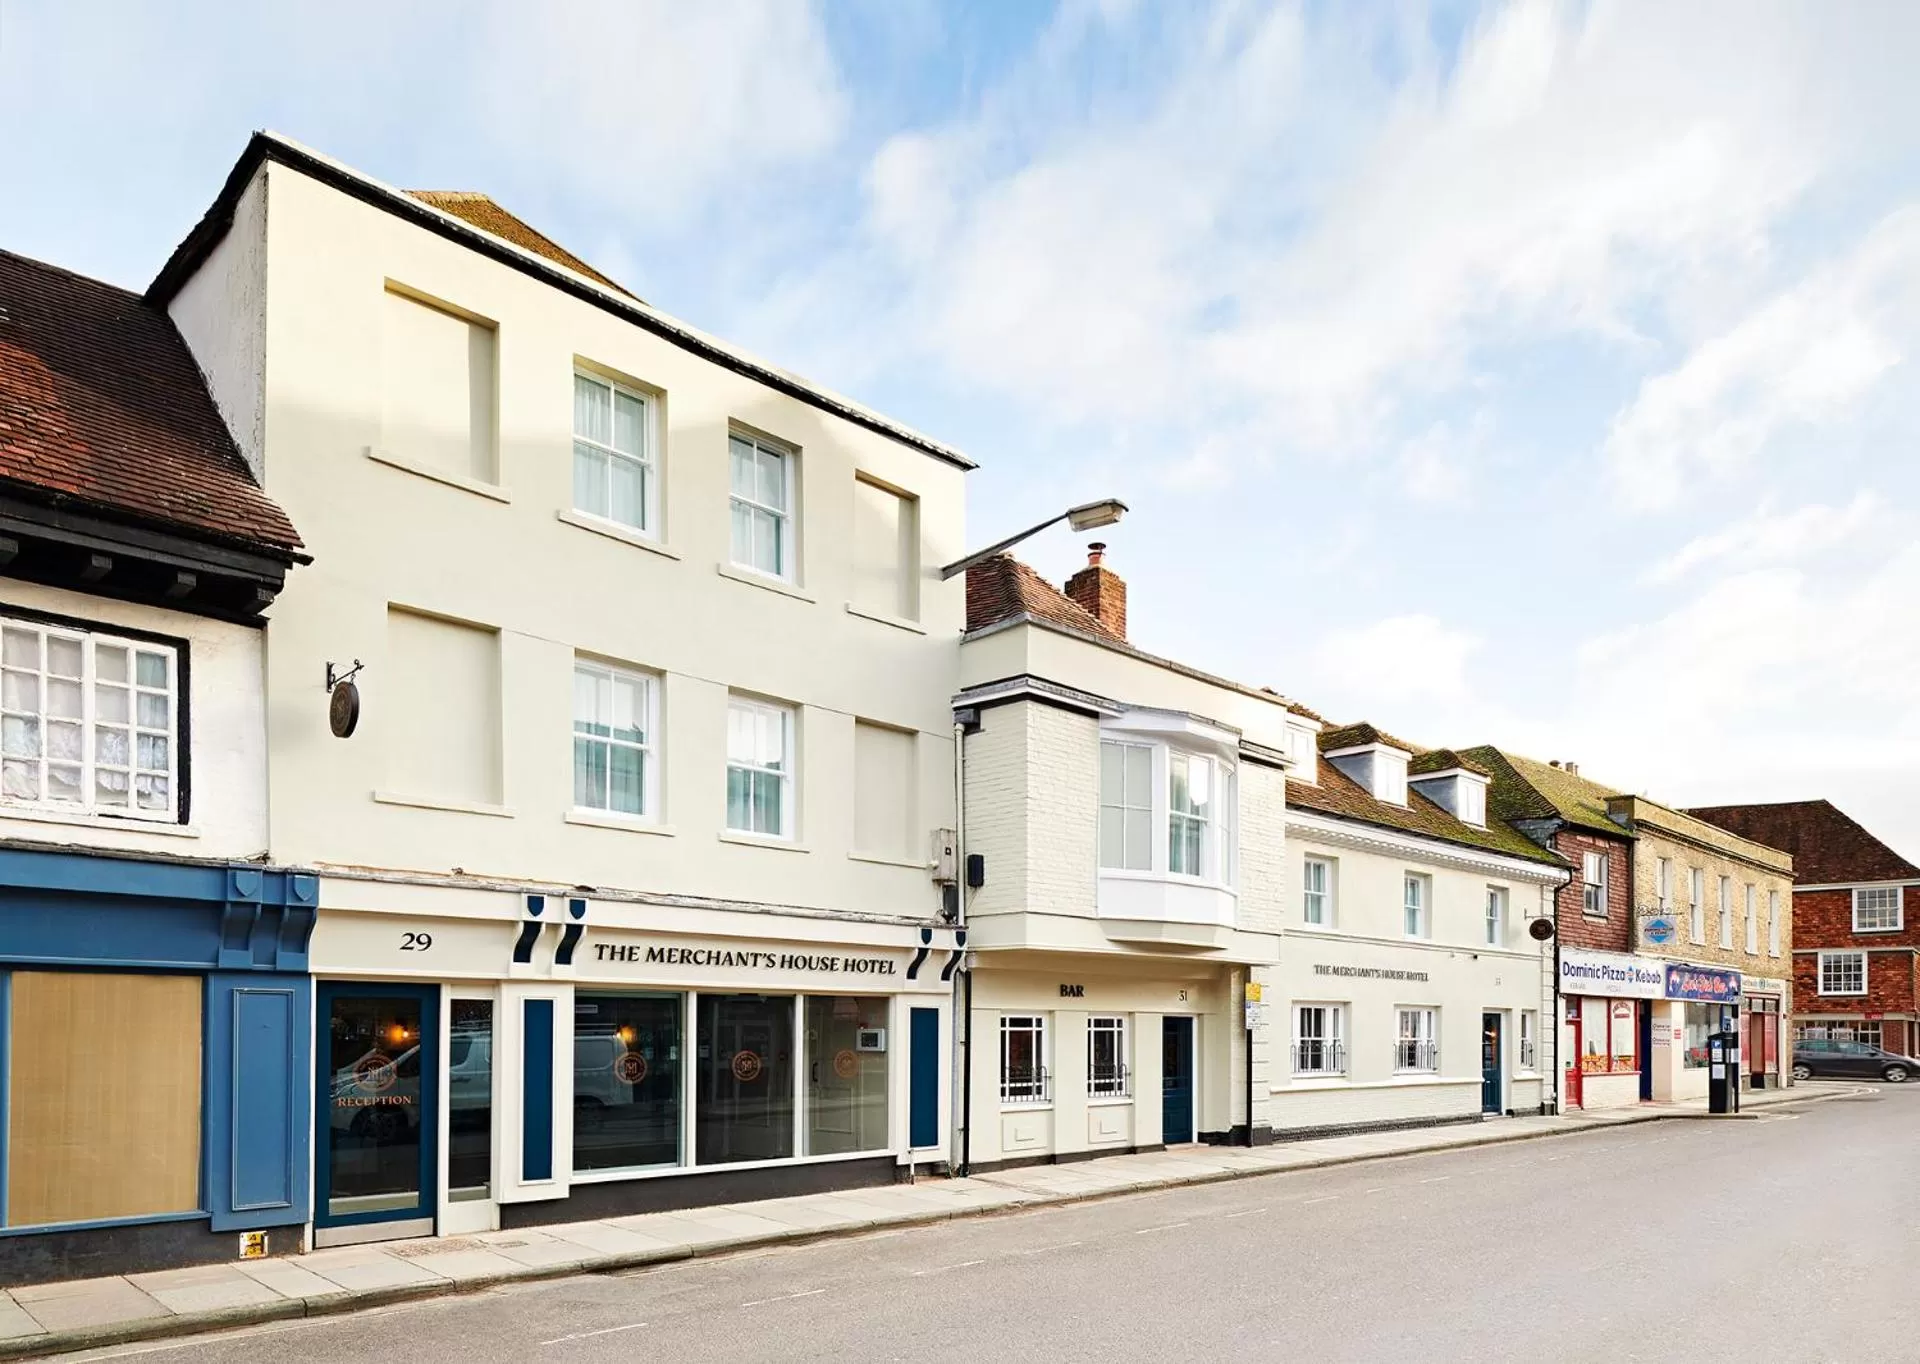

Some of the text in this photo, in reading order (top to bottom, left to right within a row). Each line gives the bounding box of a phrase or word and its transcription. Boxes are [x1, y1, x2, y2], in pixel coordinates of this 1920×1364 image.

[400, 932, 432, 951] 29
[595, 944, 897, 975] THE MERCHANT'S HOUSE HOTEL
[1314, 964, 1331, 975] THE
[1562, 961, 1661, 984] Dominic Pizza Kebab
[1060, 984, 1084, 998] BAR
[1179, 989, 1188, 1001] 31
[338, 1095, 412, 1107] RECEPTION
